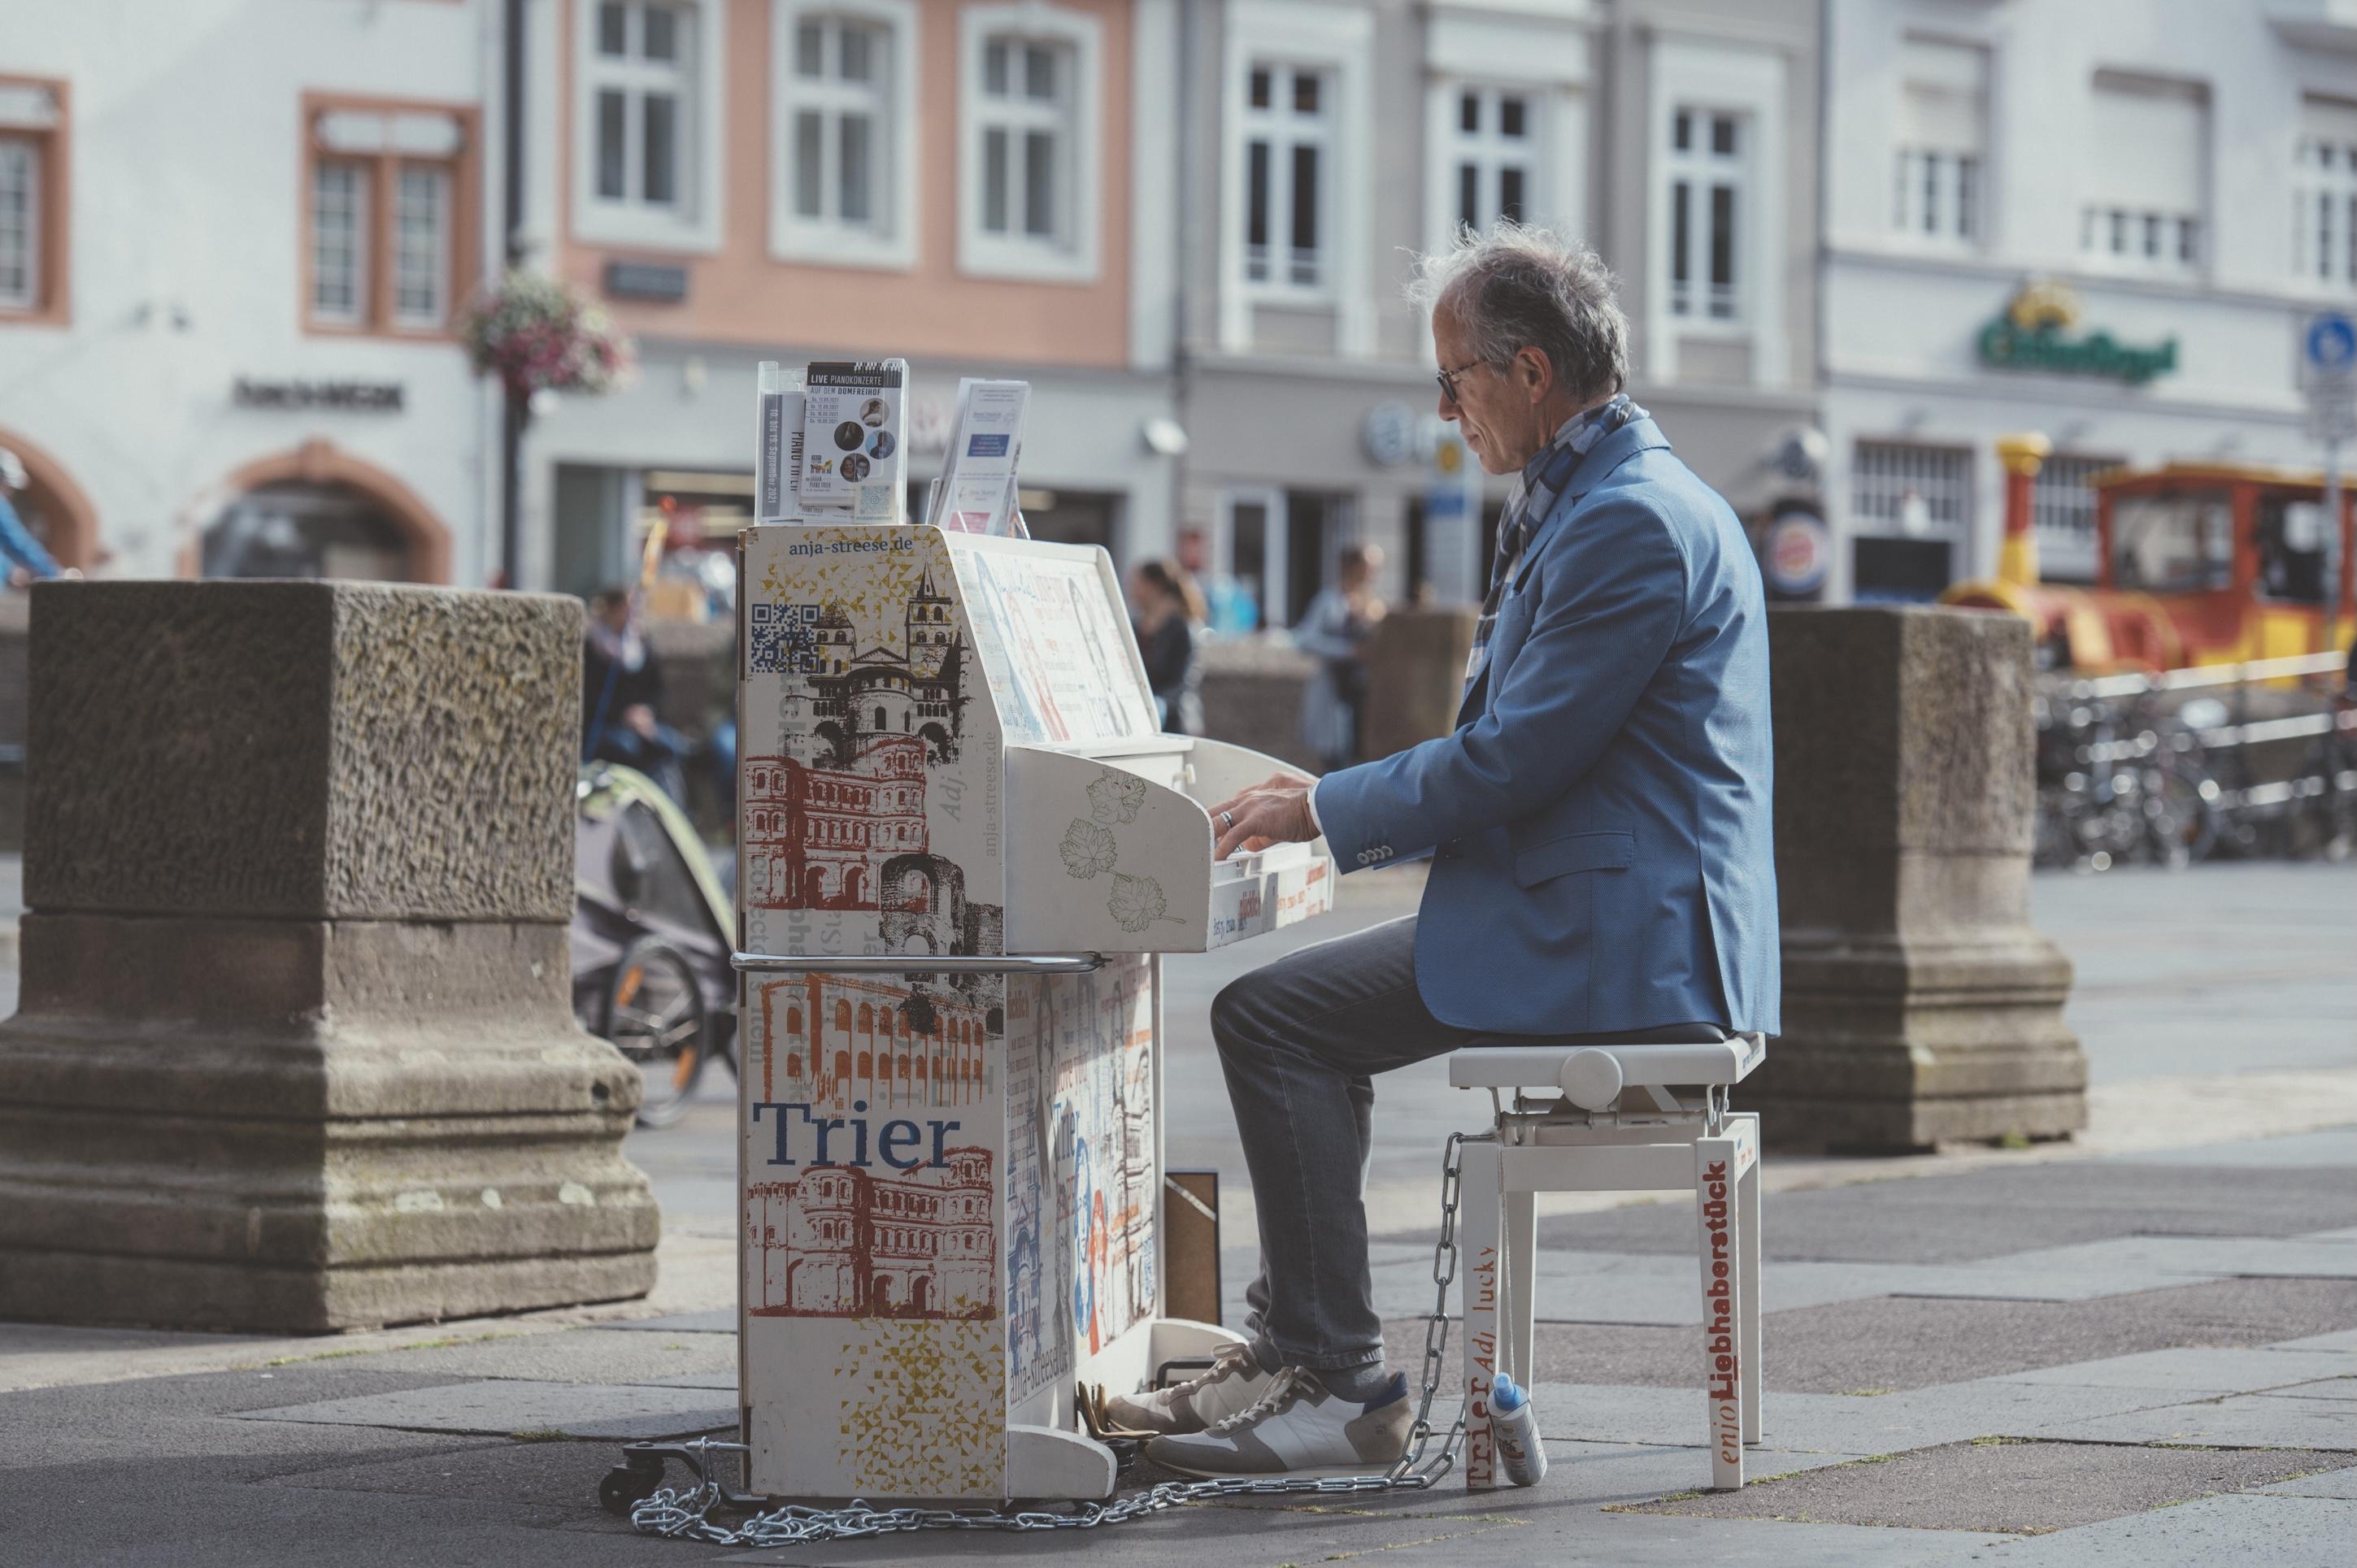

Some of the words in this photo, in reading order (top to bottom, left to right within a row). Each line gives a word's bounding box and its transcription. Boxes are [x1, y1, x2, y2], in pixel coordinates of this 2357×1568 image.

[810, 386, 822, 394] AUF
[824, 386, 836, 395] DEM
[837, 388, 882, 397] DOMFREIHOF
[811, 374, 828, 384] LIVE
[830, 375, 882, 386] PIANOKONZERTE
[768, 420, 778, 432] bis
[769, 409, 778, 419] 10.
[768, 434, 777, 445] 19.
[791, 431, 805, 461] PIANO
[766, 445, 778, 485] September
[767, 487, 777, 503] 2021
[789, 536, 913, 558] anja-streese.de
[938, 769, 968, 822] Adj.
[983, 731, 999, 858] anja-streese.de
[753, 1100, 961, 1169] Trier
[1053, 1101, 1081, 1162] Trier
[1472, 1244, 1498, 1313] lucky
[1702, 1160, 1734, 1399] Liebhaberstück
[1471, 1325, 1497, 1375] Adj.
[1466, 1376, 1493, 1488] Trier
